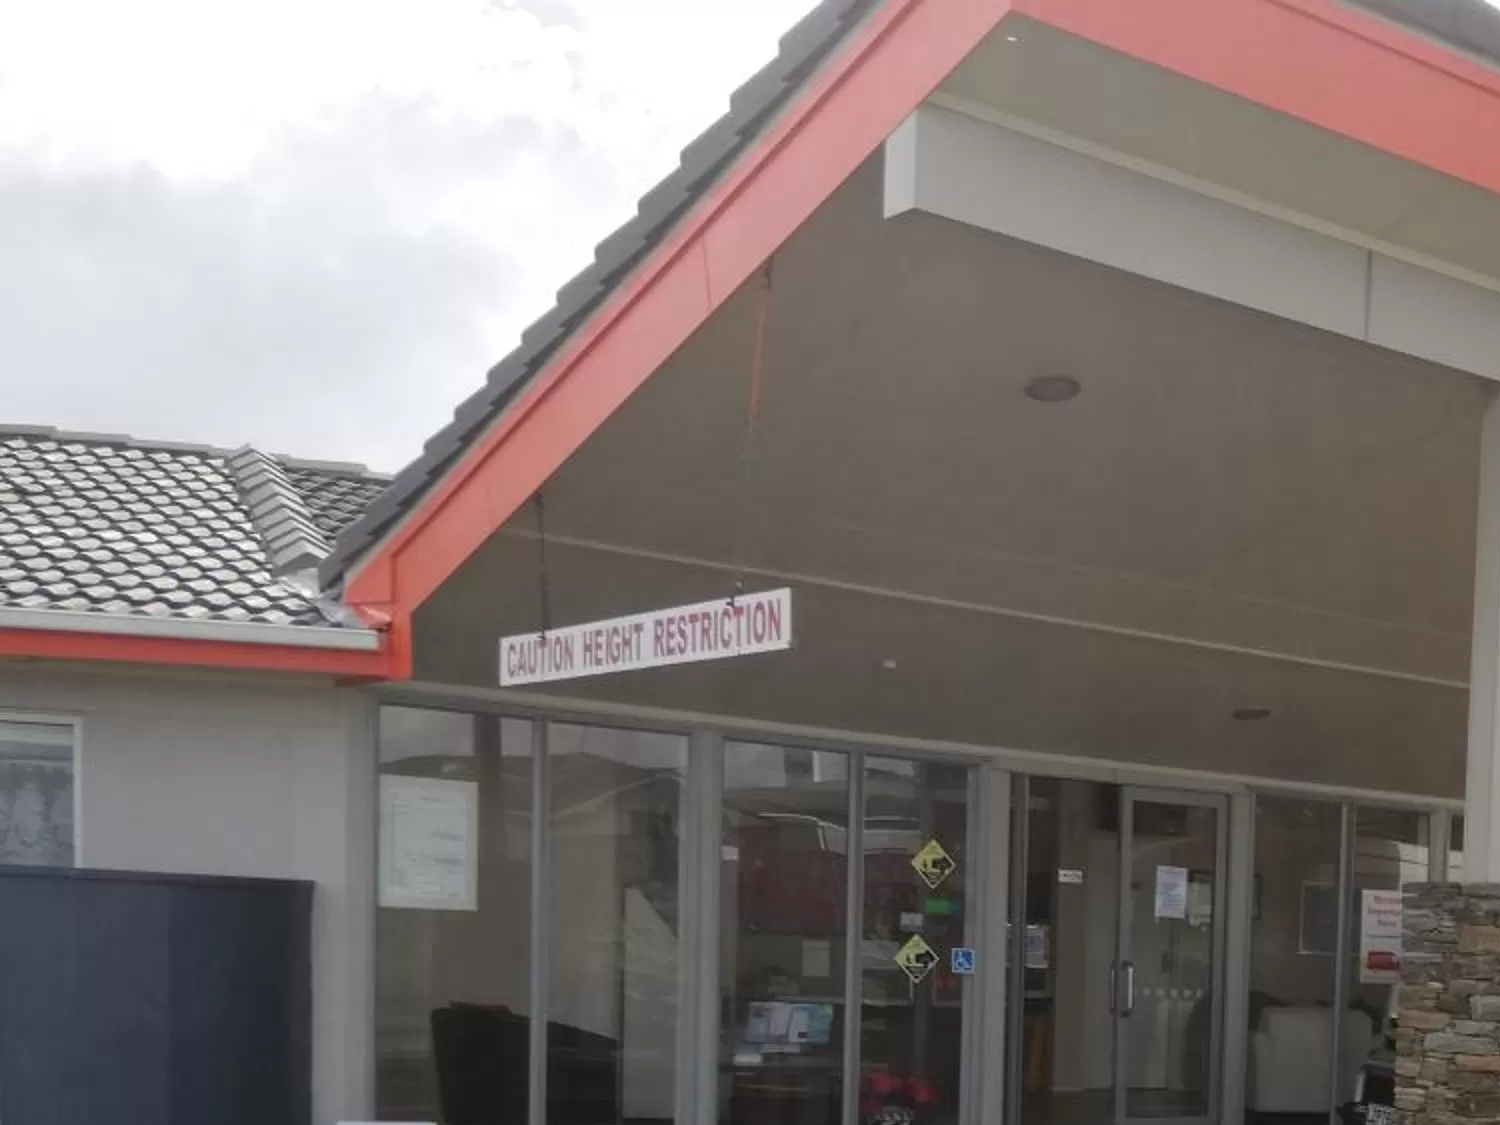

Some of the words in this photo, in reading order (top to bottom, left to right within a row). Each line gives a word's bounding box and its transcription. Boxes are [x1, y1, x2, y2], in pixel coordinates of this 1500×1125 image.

[507, 634, 575, 677] CAUTION
[582, 623, 645, 668] HEIGHT
[652, 597, 782, 658] RESTRICTION
